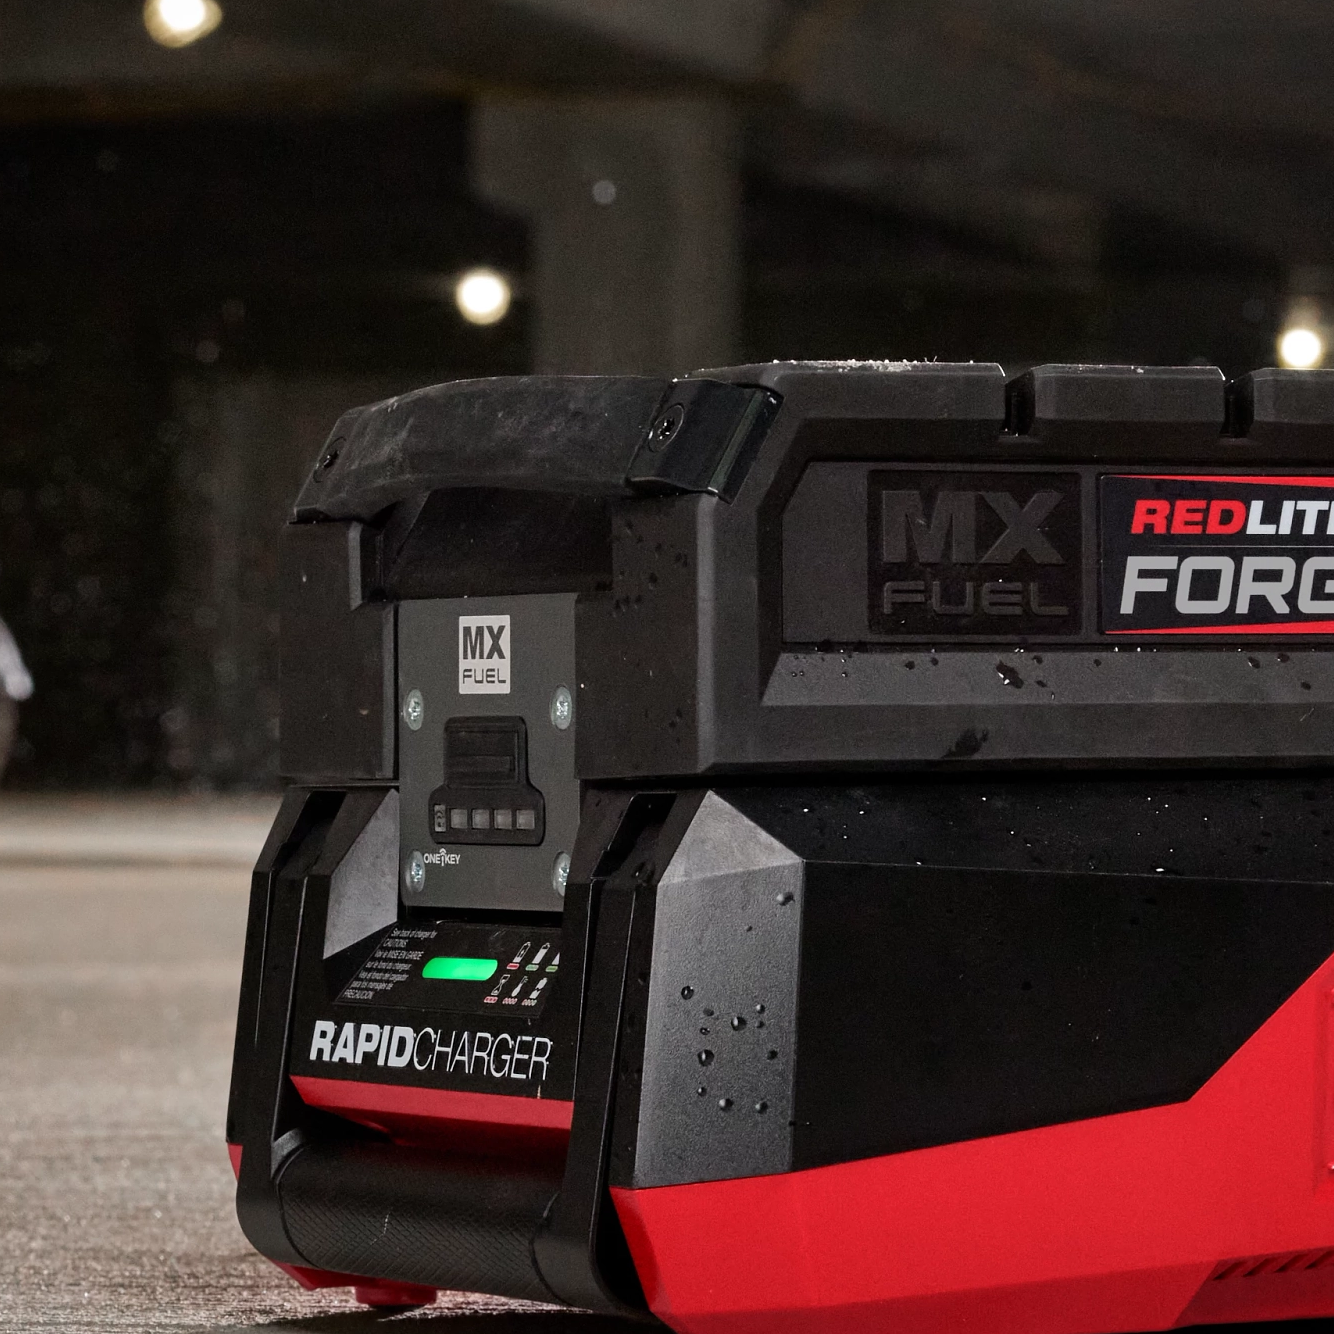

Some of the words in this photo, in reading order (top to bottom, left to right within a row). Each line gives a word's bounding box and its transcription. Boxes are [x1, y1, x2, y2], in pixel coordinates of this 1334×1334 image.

[882, 490, 1067, 564] MX
[883, 580, 1069, 616] FUEL
[462, 625, 506, 660] MX
[462, 668, 507, 685] FUEL
[309, 1020, 553, 1081] RAPIDCHARGER
